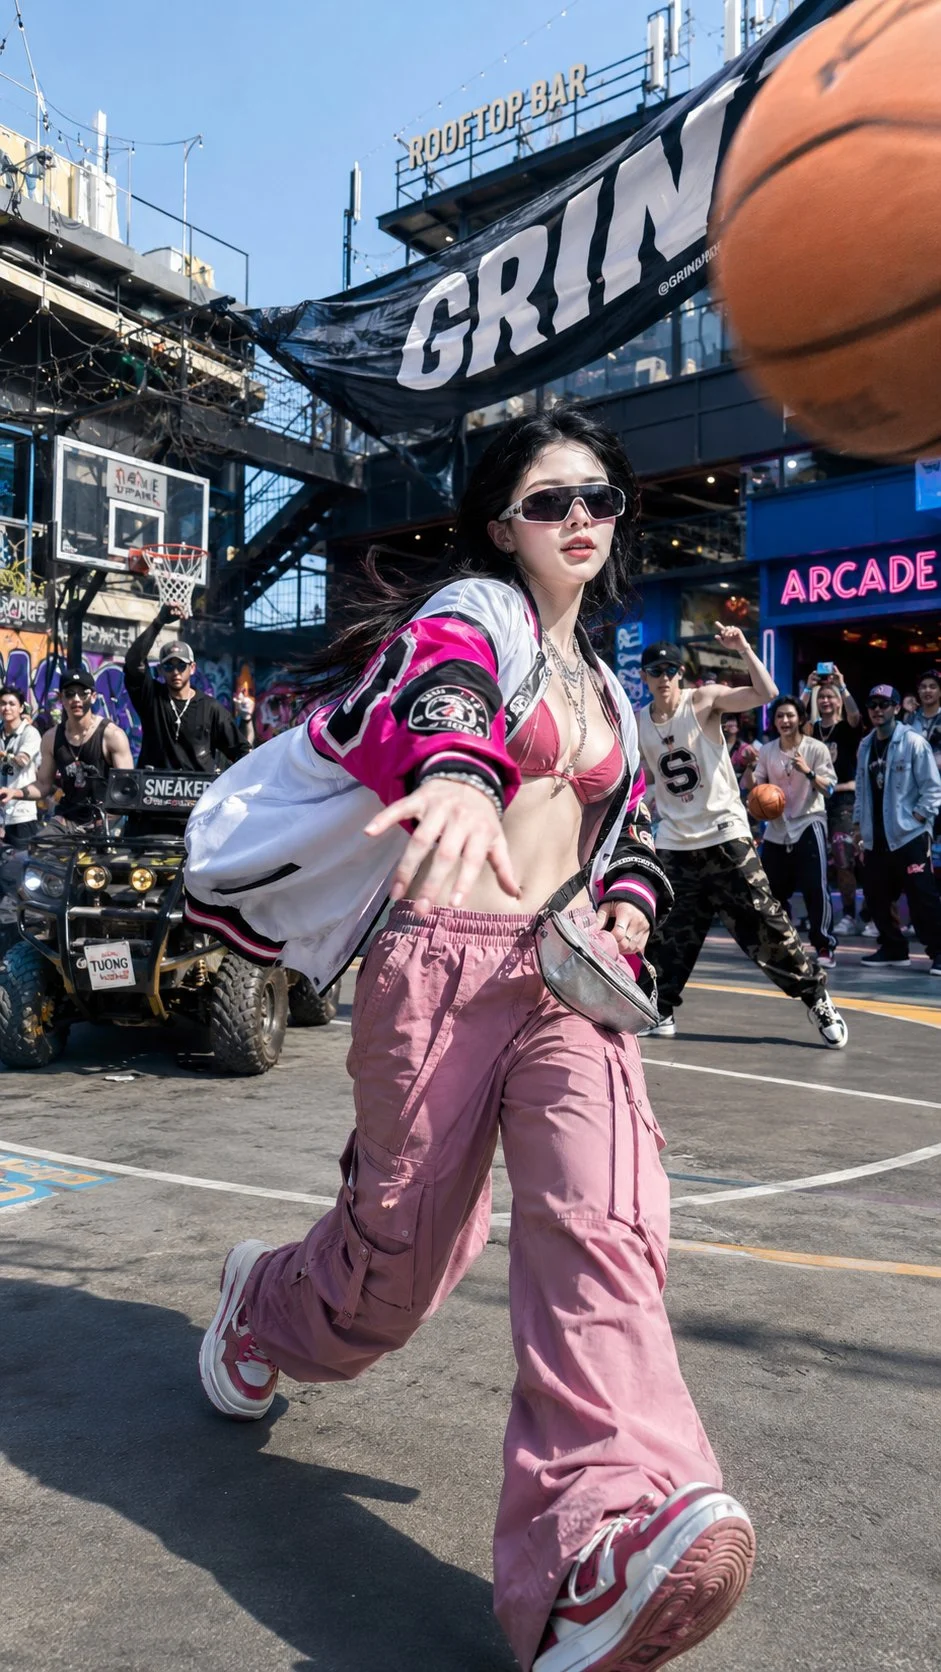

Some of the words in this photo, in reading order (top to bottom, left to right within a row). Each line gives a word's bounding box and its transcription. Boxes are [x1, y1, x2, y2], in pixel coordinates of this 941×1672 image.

[409, 90, 524, 170] ROOFTOP
[530, 63, 587, 118] BAR
[780, 550, 938, 605] ARCADE
[657, 746, 701, 797] S
[89, 957, 128, 972] TUONG
